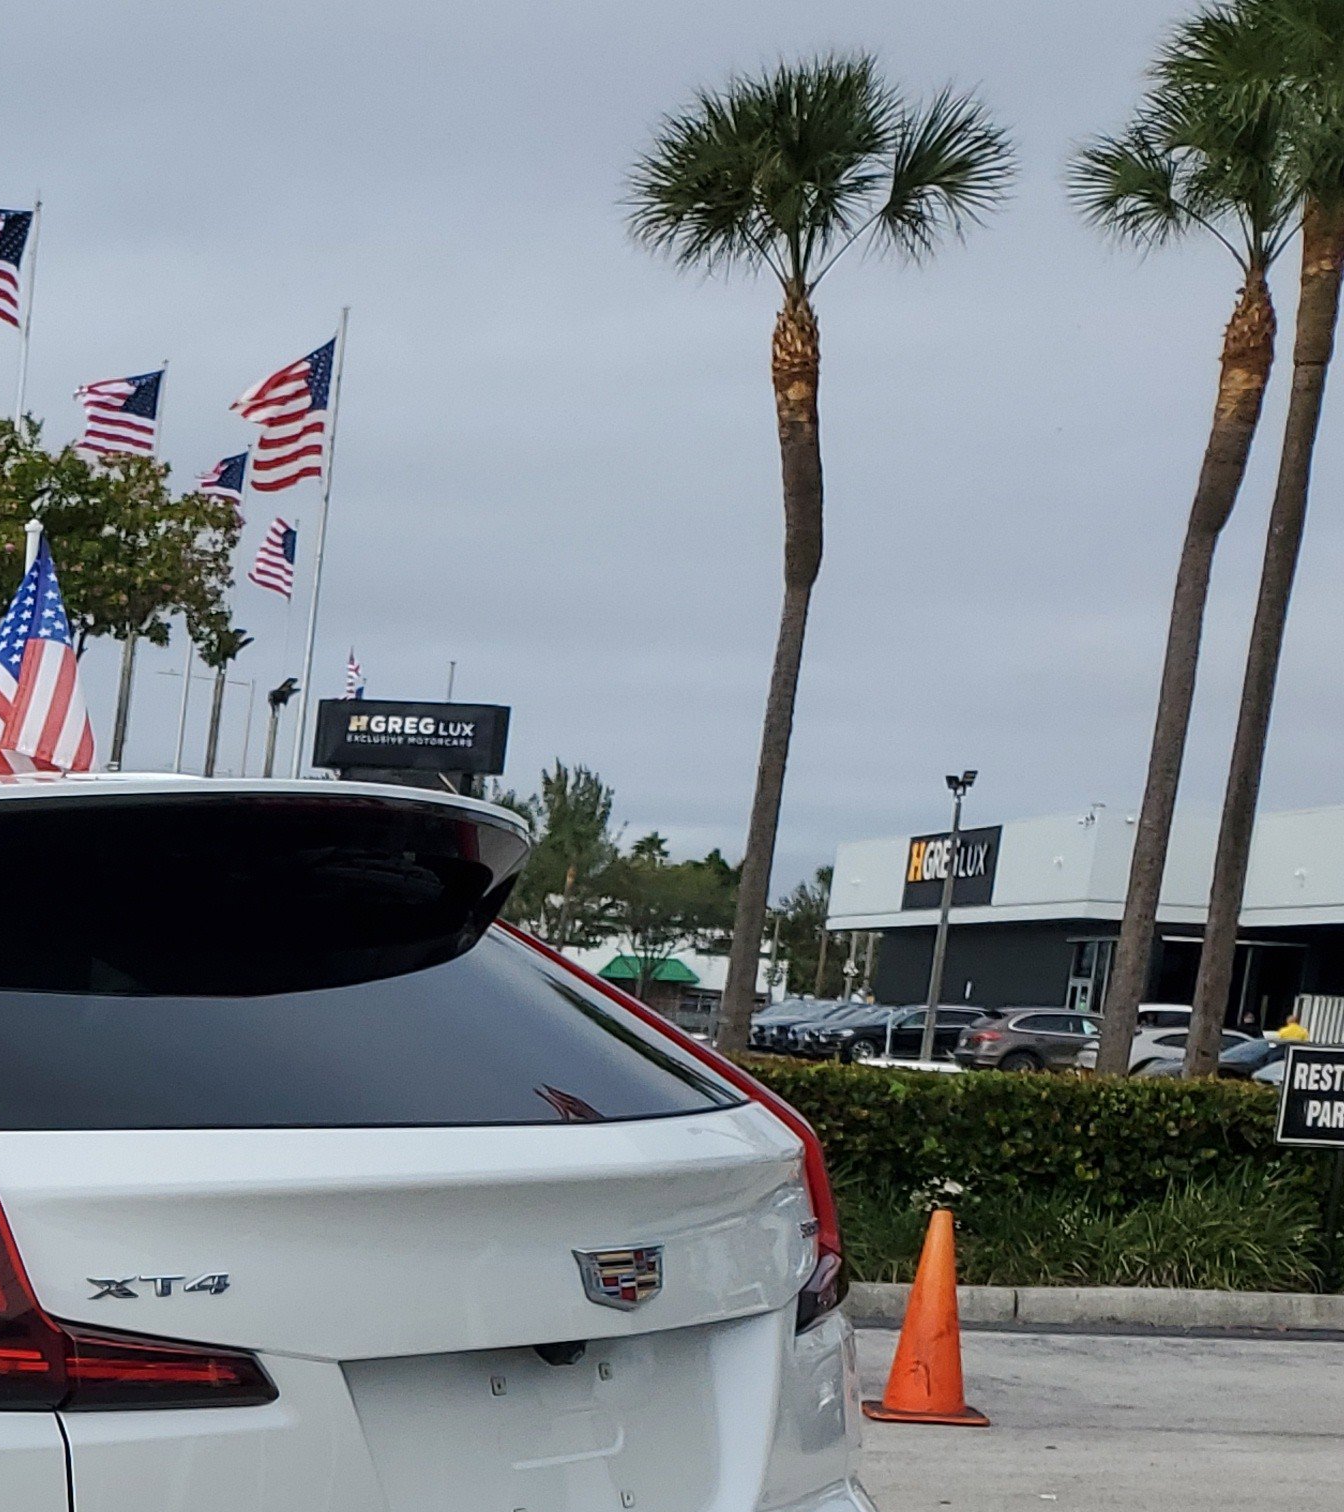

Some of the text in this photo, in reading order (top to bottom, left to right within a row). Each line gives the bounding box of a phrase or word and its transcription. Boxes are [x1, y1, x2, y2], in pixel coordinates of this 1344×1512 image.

[345, 733, 473, 748] EXCLUSIVE MOTORCARS
[438, 721, 475, 738] LUX
[1293, 1062, 1344, 1092] REST
[86, 1271, 230, 1300] XT4
